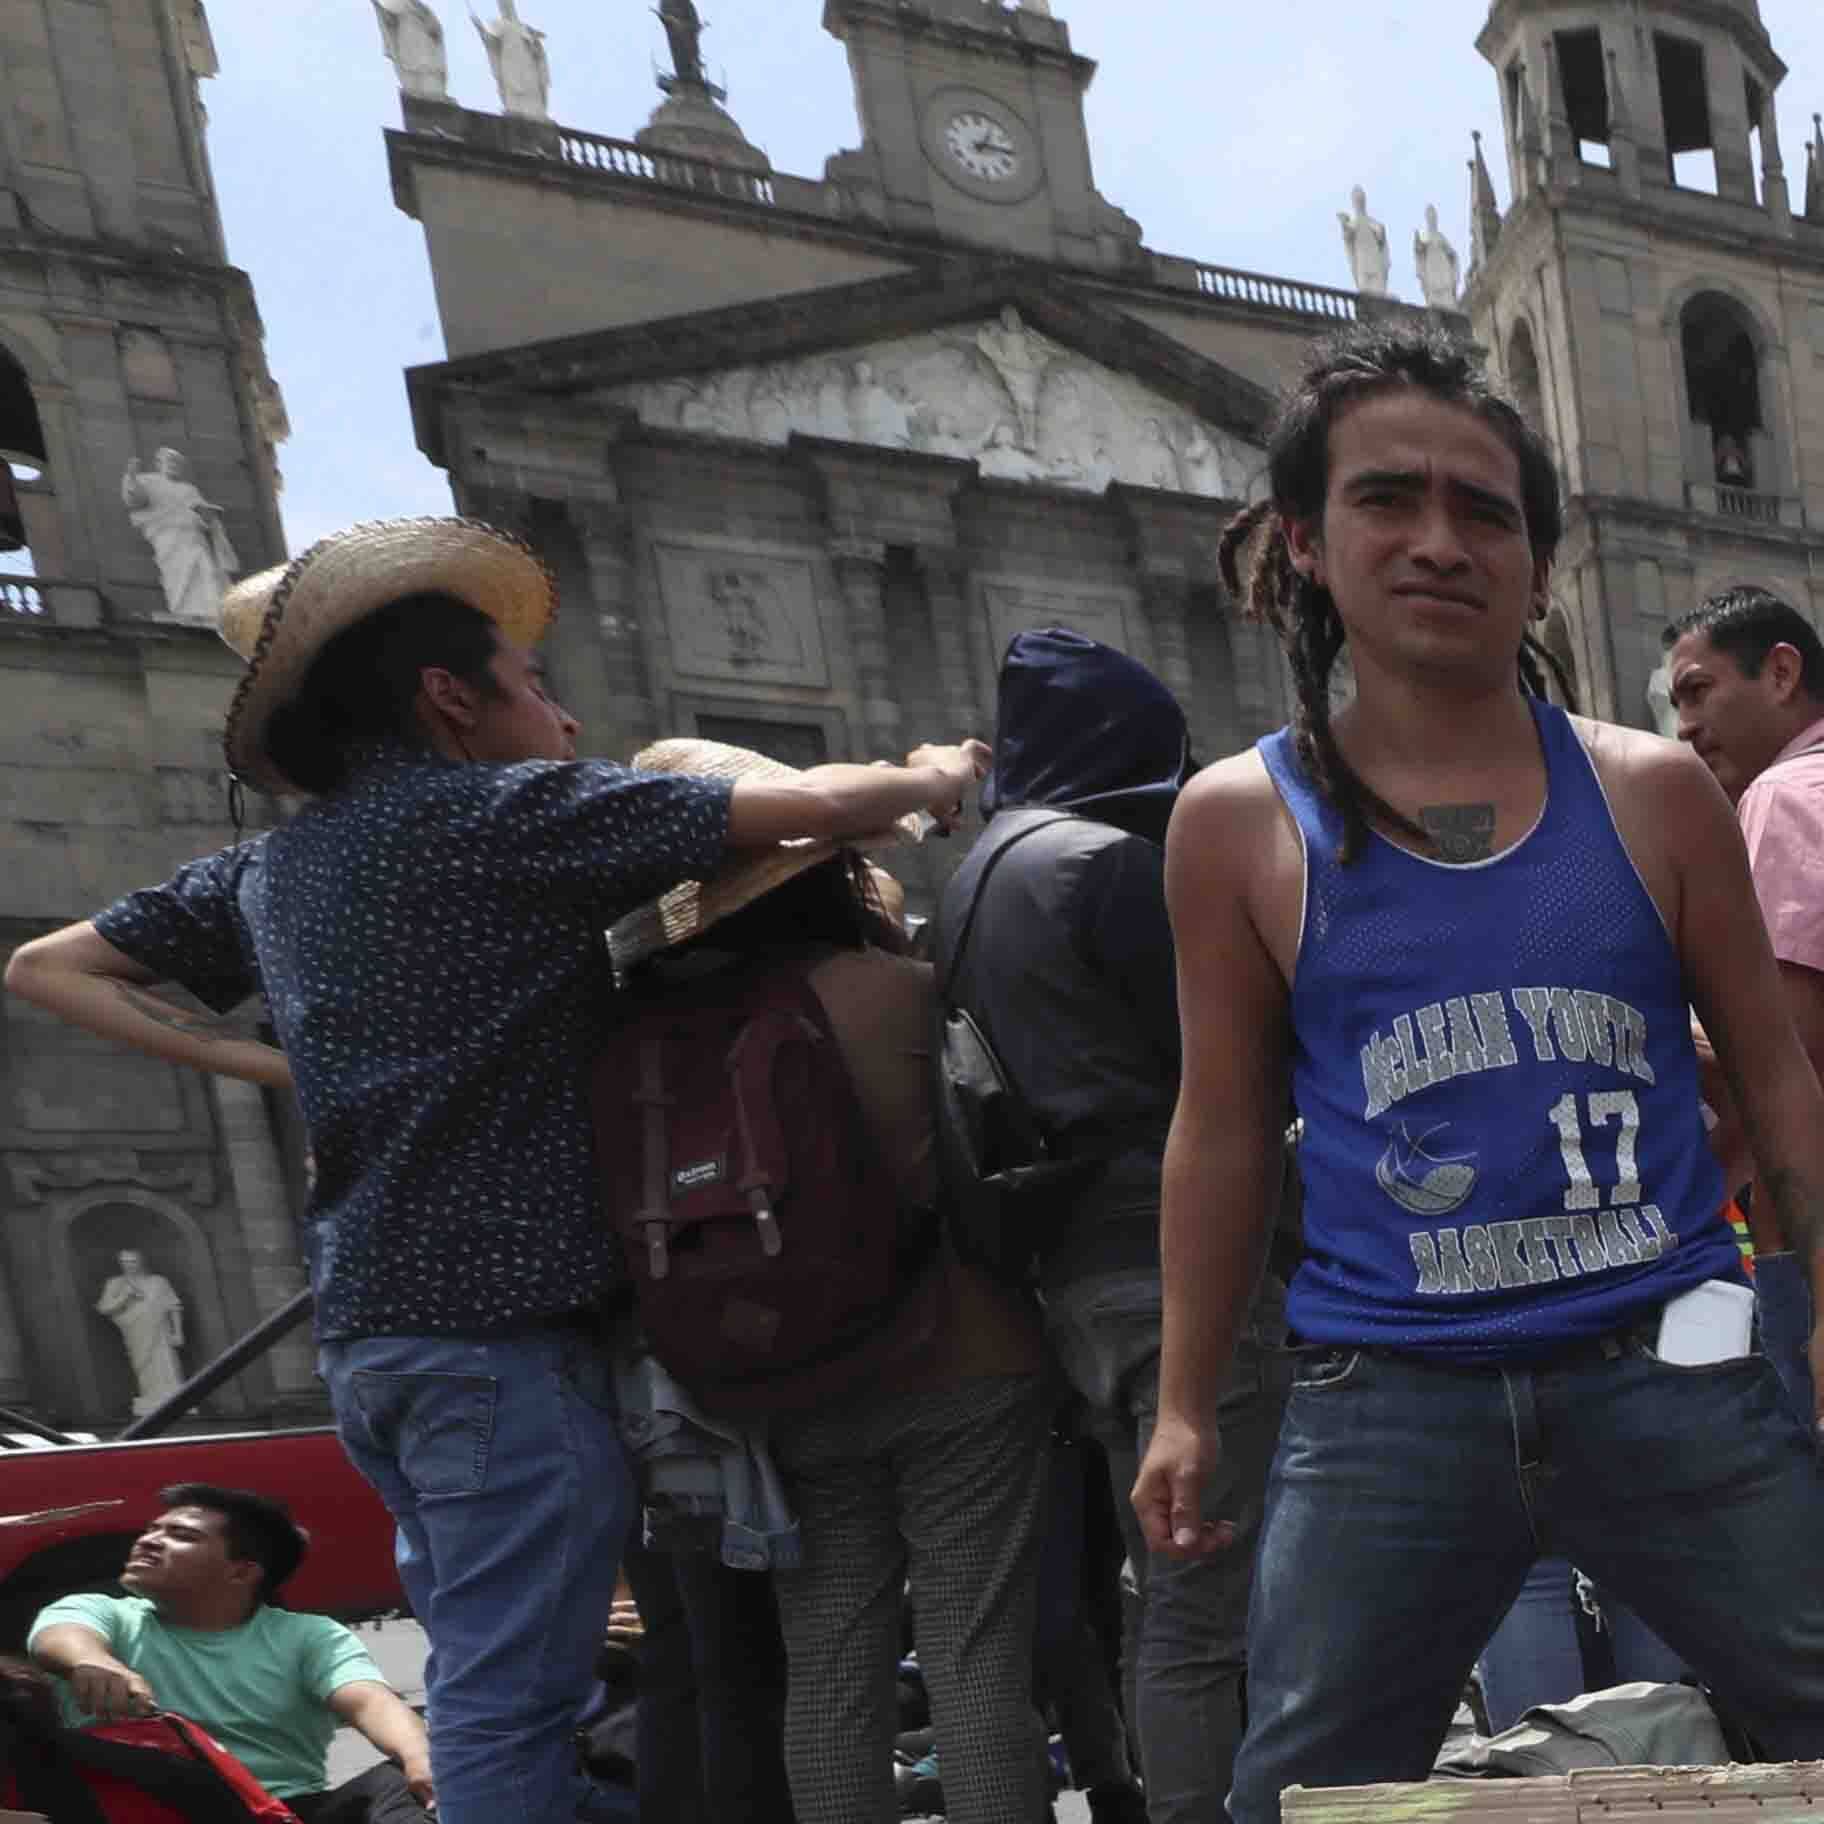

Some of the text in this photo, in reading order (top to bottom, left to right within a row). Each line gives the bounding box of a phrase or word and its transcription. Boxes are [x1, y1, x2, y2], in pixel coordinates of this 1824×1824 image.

[1512, 987, 1656, 1087] YOUTH
[1548, 1090, 1642, 1210] 17
[1409, 1204, 1679, 1294] BASKETBALL
